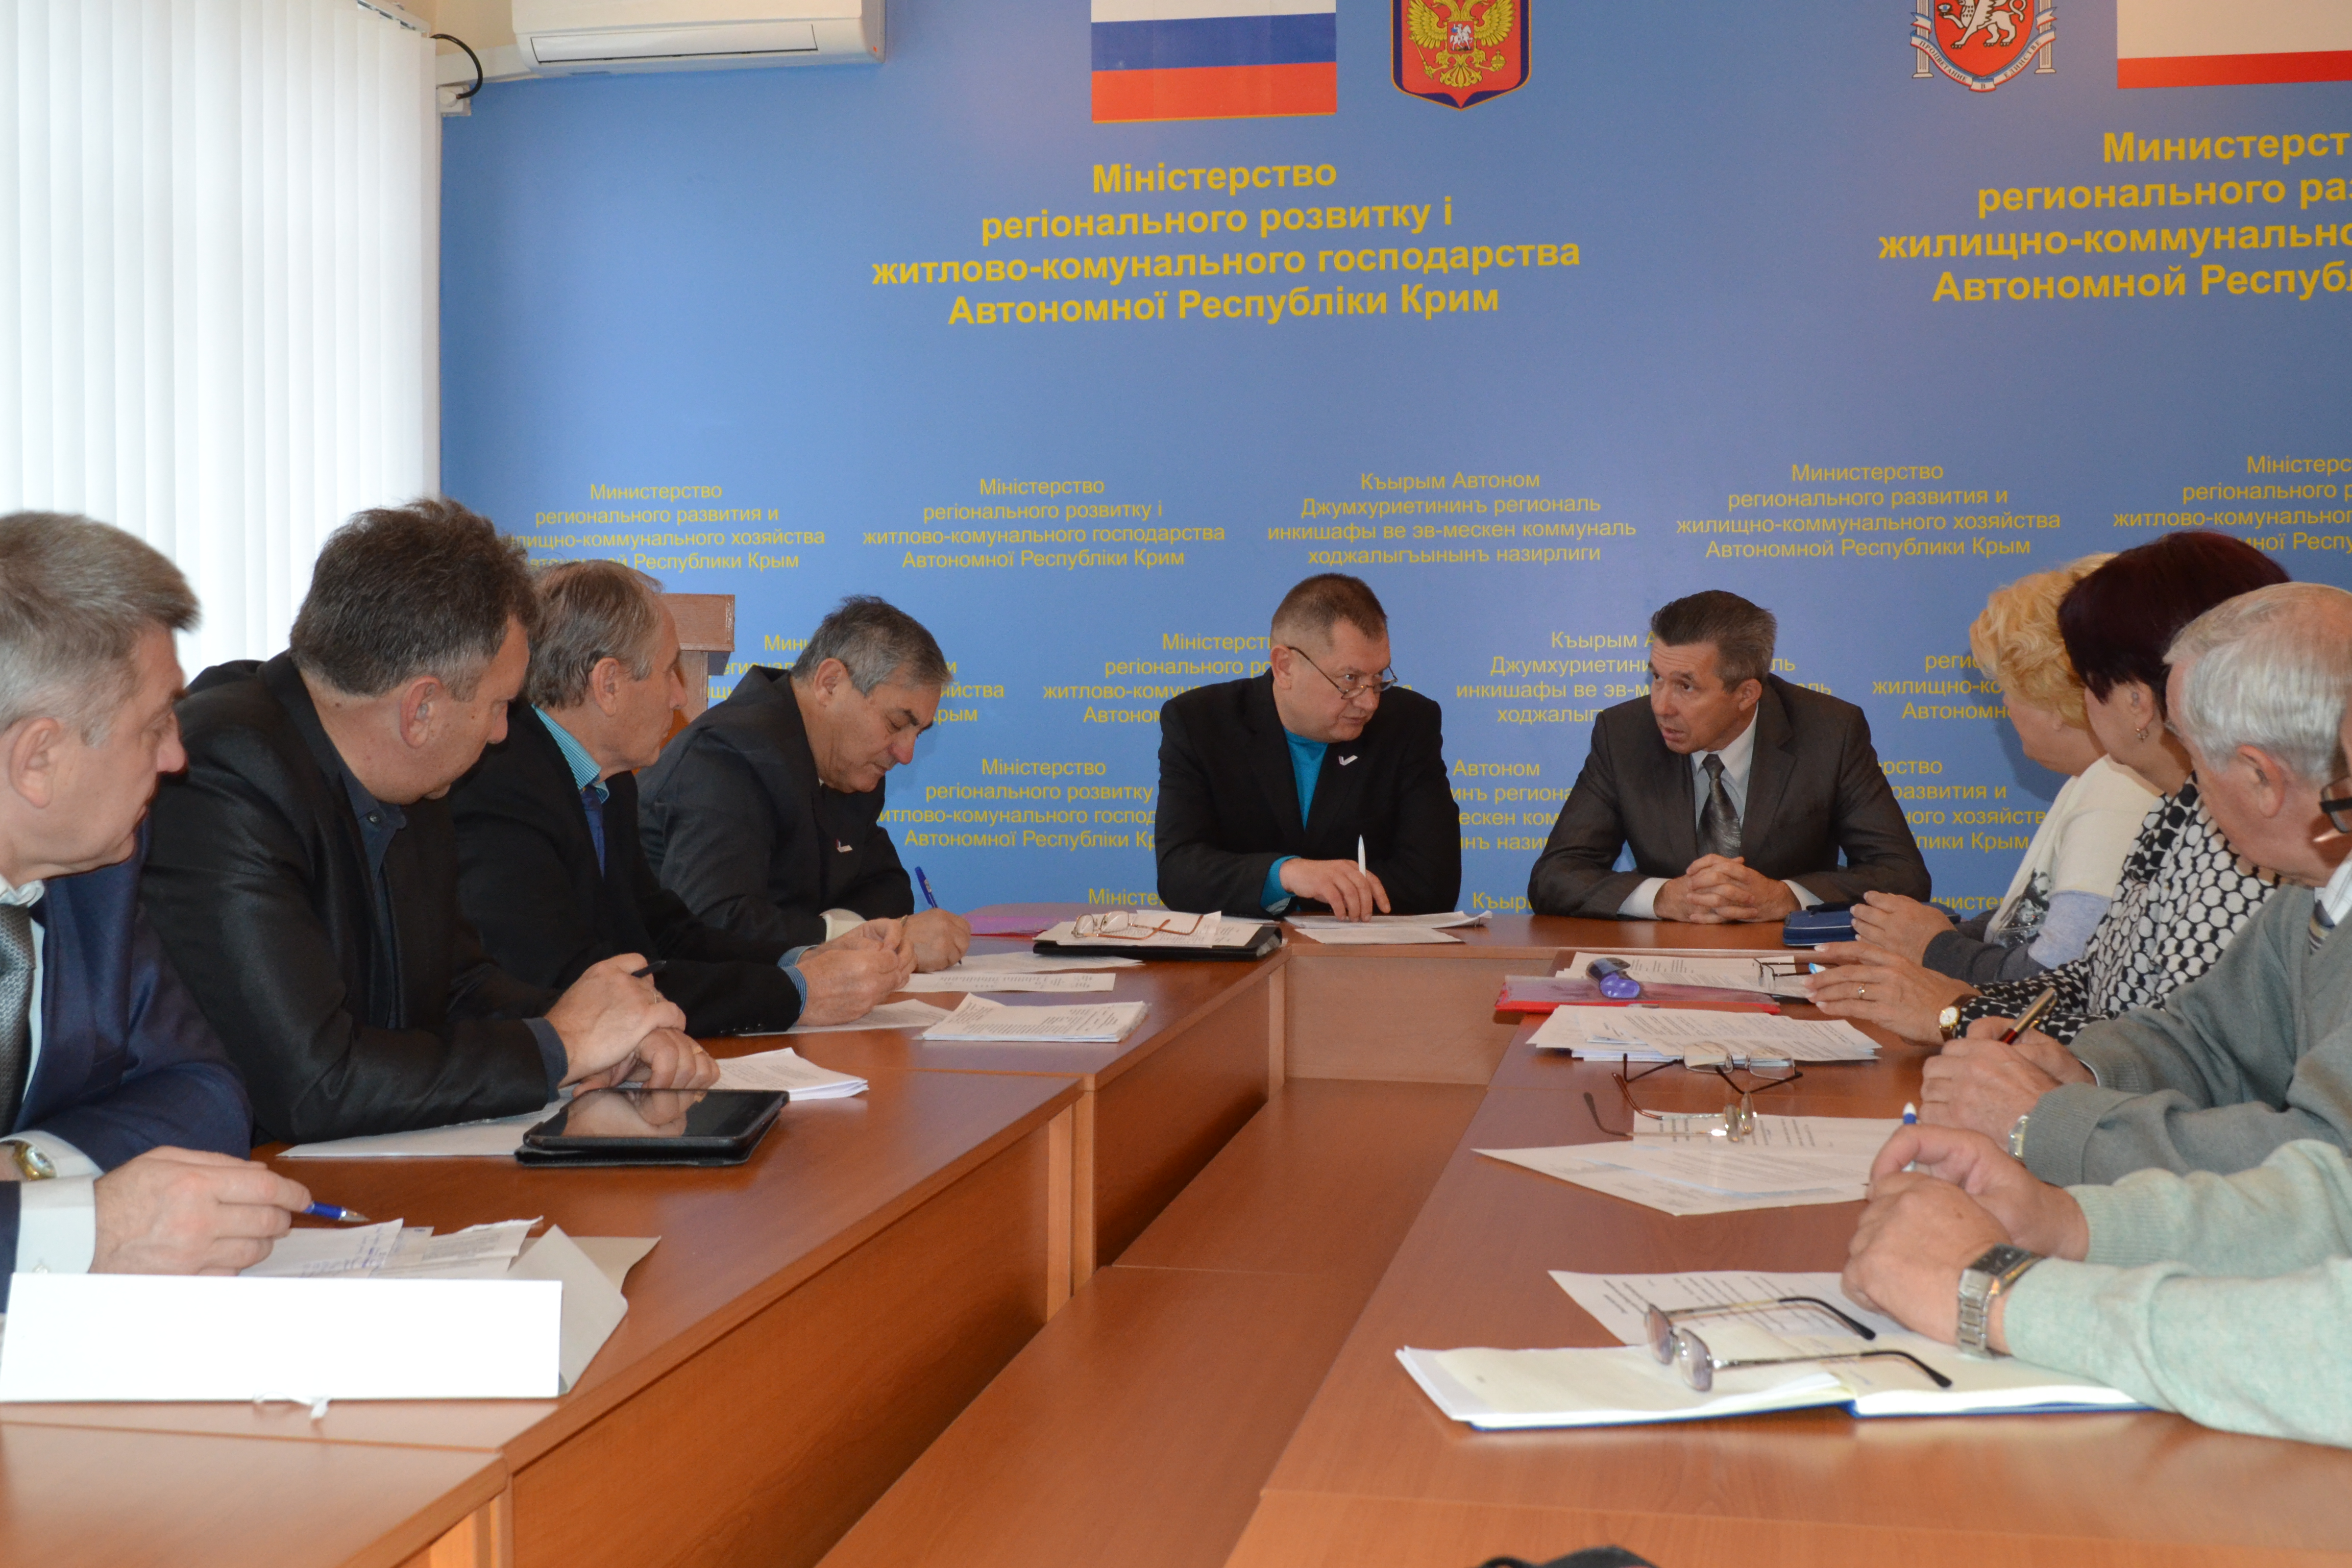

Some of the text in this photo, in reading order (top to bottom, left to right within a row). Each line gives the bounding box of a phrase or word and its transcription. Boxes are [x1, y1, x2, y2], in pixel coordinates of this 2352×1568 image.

[1920, 41, 1967, 82] ПРОЦВЕТАНИЕ
[2003, 40, 2041, 78] ЕДИНСТВЕ
[2104, 132, 2350, 165] Министерст
[1094, 163, 1336, 196] Міністерство
[1979, 180, 2286, 219] регионального
[983, 197, 1452, 247] регіонального розвитку і
[872, 243, 1580, 286] житлово-комунального господарства
[1932, 260, 2352, 302] Автономной Респуб
[949, 284, 1498, 325] Автономної Республіки Крим
[1361, 472, 1540, 493] Къырым Автоном
[1792, 464, 1944, 484] Министерство
[591, 484, 722, 502] Министерство
[981, 479, 1105, 498] Міністерство
[2183, 482, 2337, 504] регіонального
[1301, 498, 1601, 519] Джумхуриетининъ региональ
[1729, 491, 2007, 511] регионального развития и
[536, 509, 778, 528] регионального развития и
[924, 504, 1162, 523] регіонального розвитку і
[1677, 512, 2060, 535] жилищно-коммунального хозяйства
[511, 529, 825, 548] лищно-коммунального хозяйства
[864, 527, 1225, 547] житлово-комунального господарства
[1268, 523, 1636, 543] инкишафы ве эв-мескен коммуналь
[1309, 548, 1600, 566] ходжалыгъынынъ назирлиги
[1706, 537, 2030, 559] Автономной Республики Крым
[634, 553, 742, 573] Республики
[749, 552, 799, 571] Крым
[902, 549, 1184, 570] Автономної Республіки Крим
[1163, 633, 1270, 653] Міністерст
[1552, 631, 1637, 652] Къырым
[1106, 661, 1244, 678] регіонального
[1457, 681, 1566, 701] инкишафы
[1574, 684, 1597, 697] ве
[934, 709, 977, 725] рым
[1902, 702, 2010, 719] Автономн
[982, 758, 1107, 778] Міністерство
[1453, 760, 1540, 776] Автоном
[926, 786, 1153, 803] регіонального розвитку
[1995, 786, 2006, 798] и
[876, 808, 1088, 827] итлово-комунального
[905, 830, 1016, 846] Автономної
[1023, 830, 1129, 851] Республіки
[1972, 832, 2029, 853] Крым
